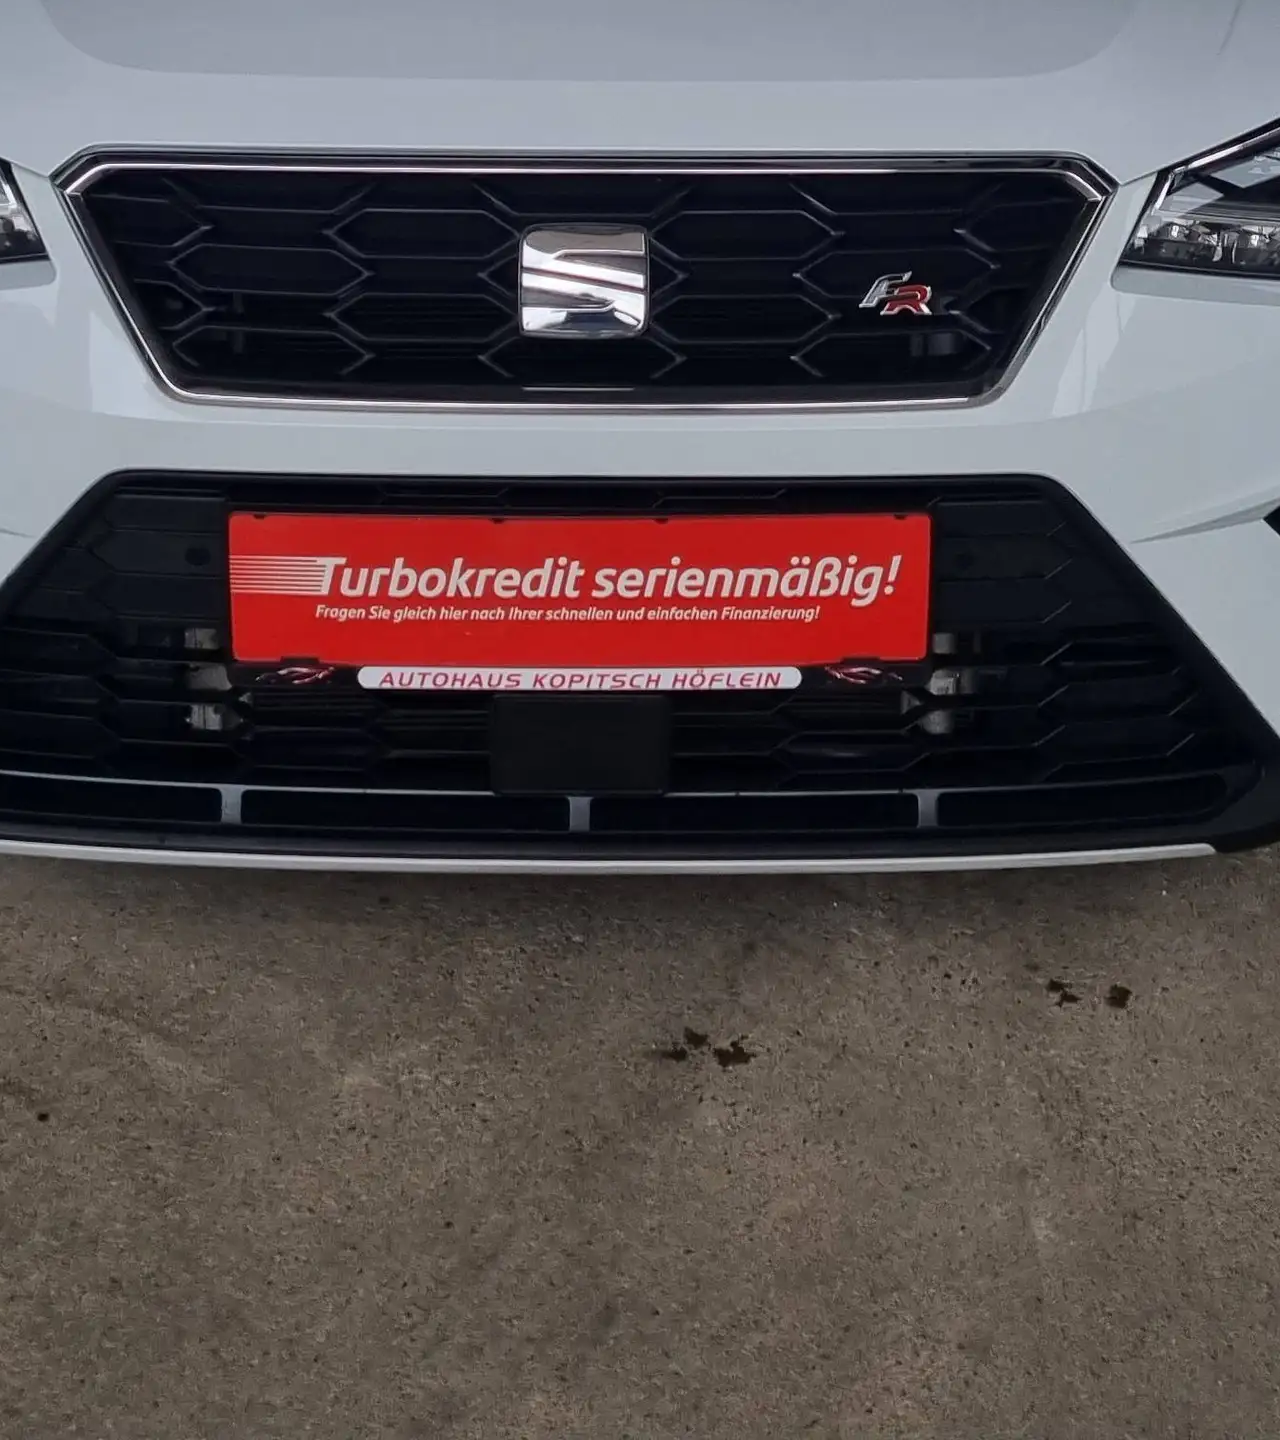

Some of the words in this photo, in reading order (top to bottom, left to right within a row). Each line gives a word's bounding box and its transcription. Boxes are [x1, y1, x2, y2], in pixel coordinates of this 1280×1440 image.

[316, 557, 585, 599] Turbokredit
[591, 555, 902, 607] serienmäßig!
[315, 604, 367, 622] Fragen
[369, 605, 391, 620] Sie
[393, 605, 436, 623] gleich
[440, 605, 468, 620] hier
[471, 606, 505, 620] nach
[508, 606, 544, 620] Ihrer
[545, 606, 613, 621] schnellen
[616, 606, 645, 621] und
[647, 606, 718, 621] einfachen
[721, 605, 821, 623] Finanzierung!
[378, 671, 522, 689] AUTOHAUS
[532, 672, 661, 689] KOPITSCH
[671, 668, 782, 688] HÖFLEIN
